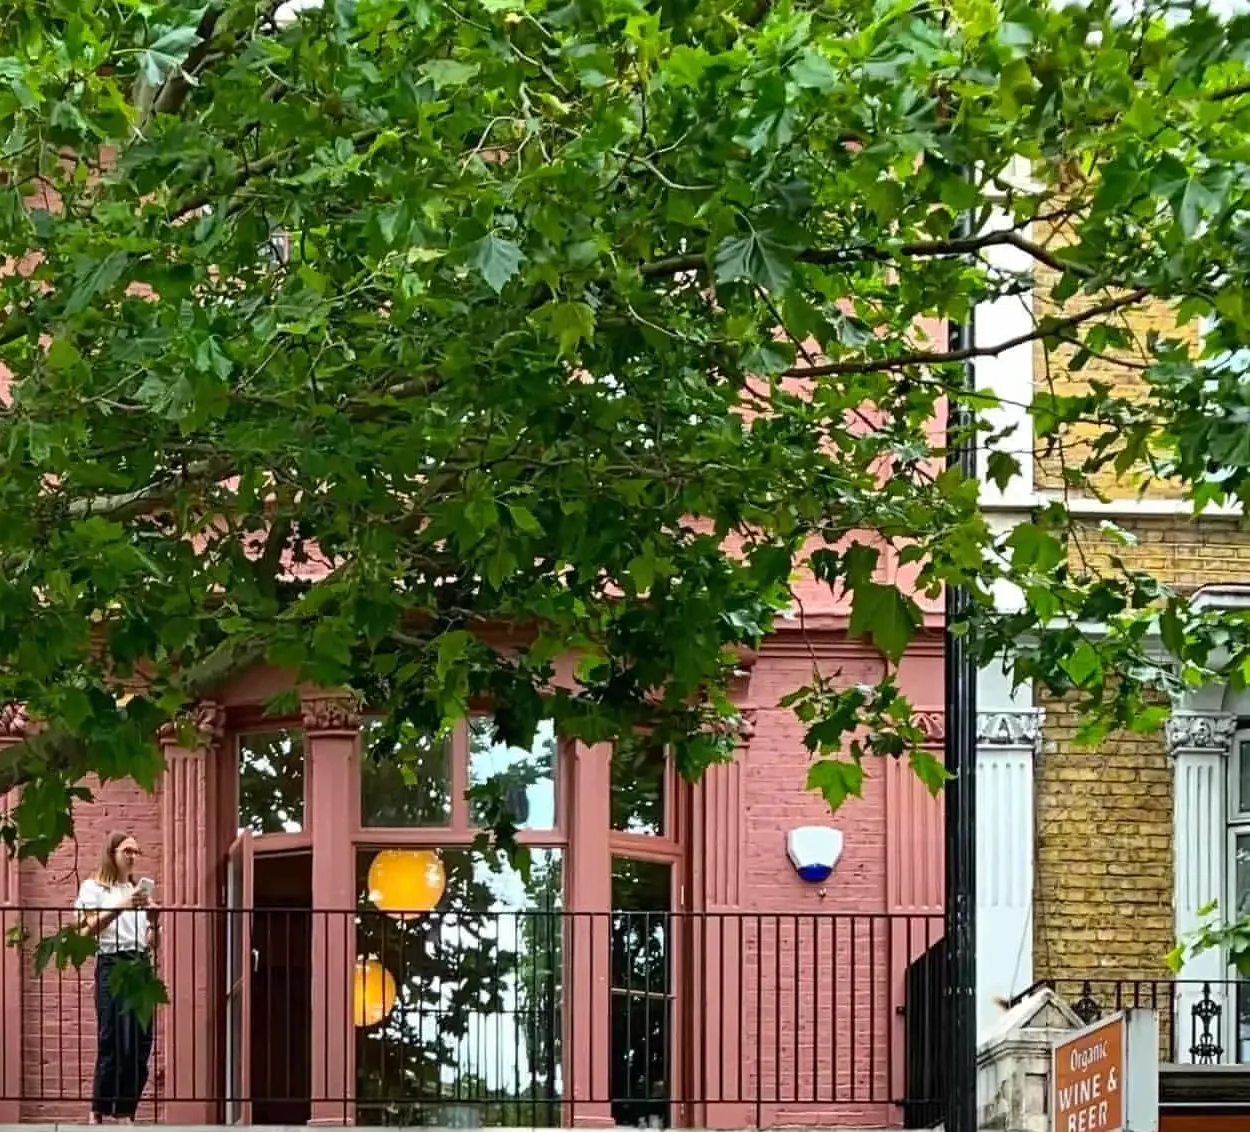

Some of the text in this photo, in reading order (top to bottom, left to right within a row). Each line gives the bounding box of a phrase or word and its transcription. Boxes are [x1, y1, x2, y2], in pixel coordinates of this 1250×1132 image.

[1070, 1037, 1110, 1072] Organic
[1058, 1066, 1118, 1113] WINE &
